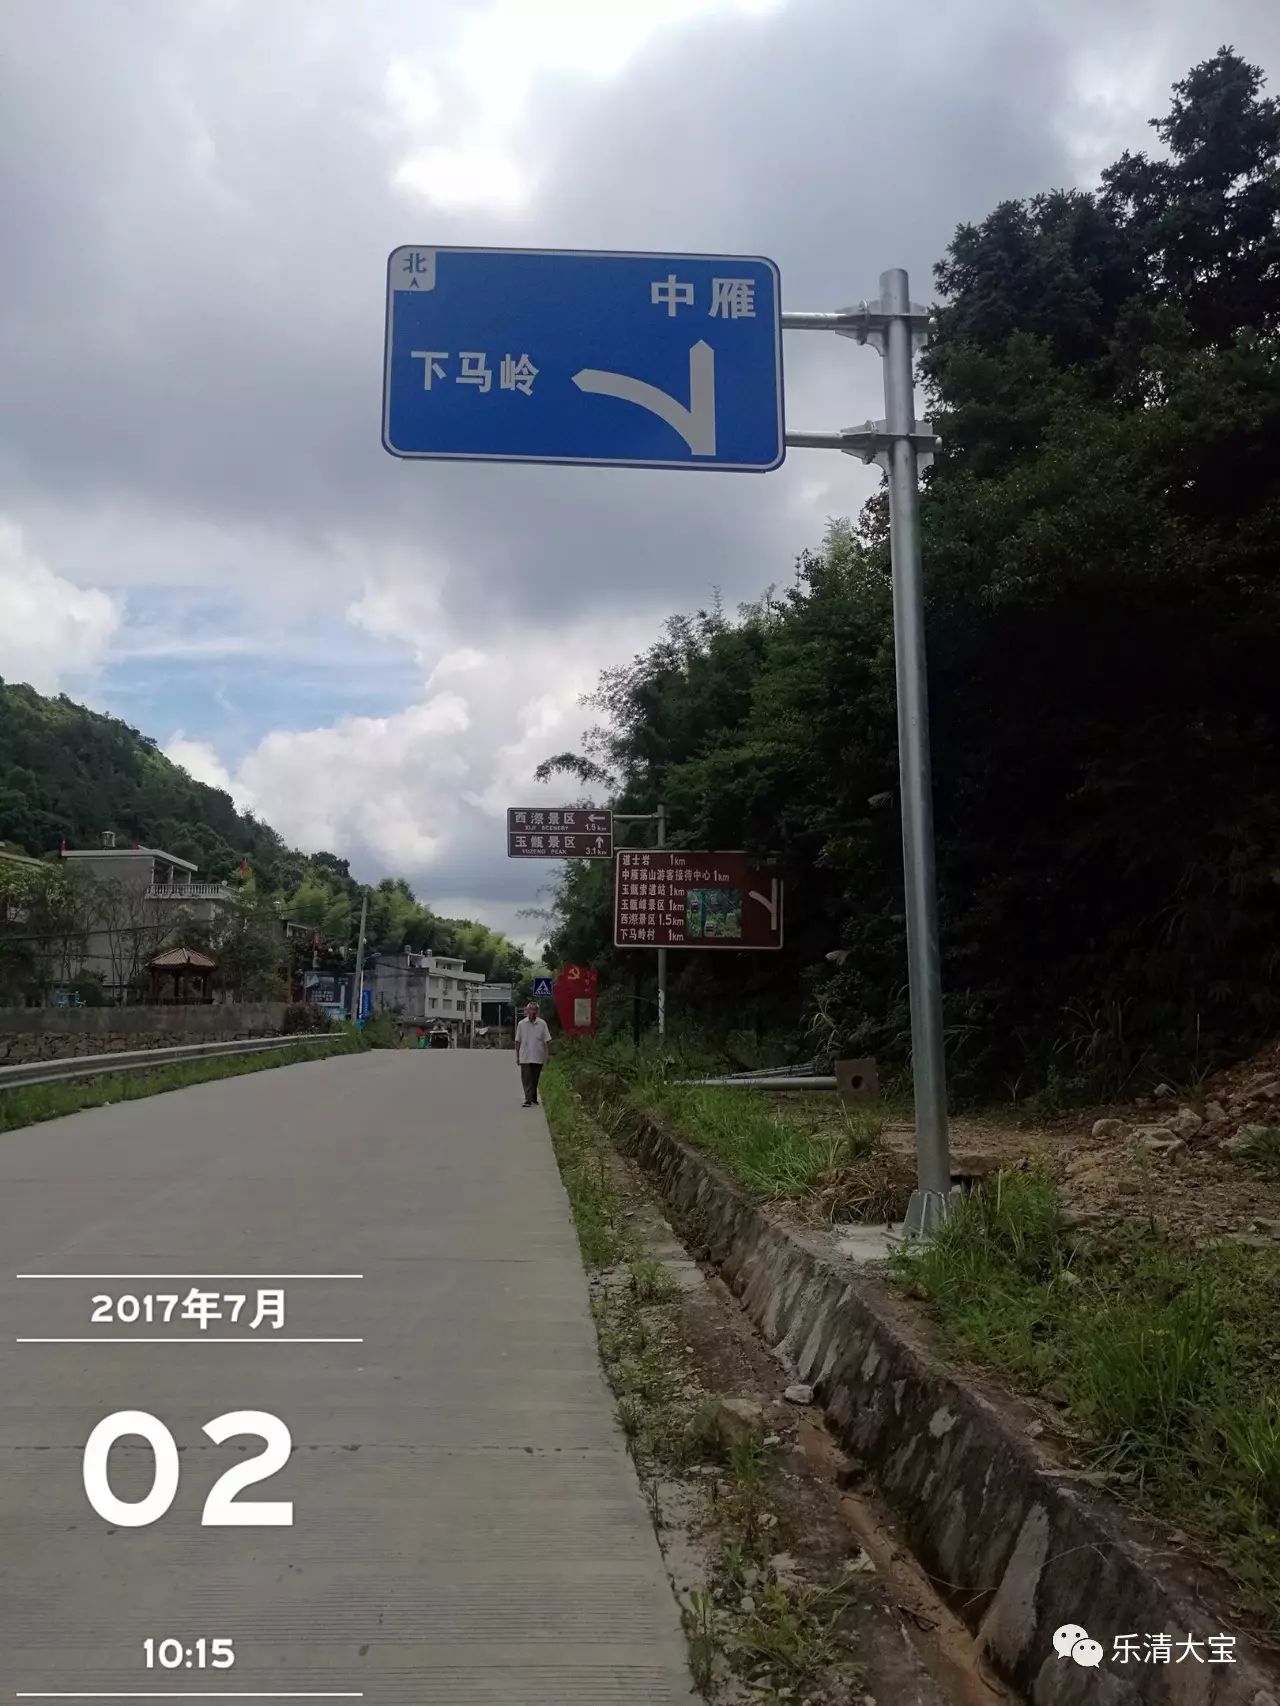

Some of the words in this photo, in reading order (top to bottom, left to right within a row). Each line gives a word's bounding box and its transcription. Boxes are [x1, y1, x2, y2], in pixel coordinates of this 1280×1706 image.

[402, 252, 427, 274] 北
[651, 274, 756, 319] 中雁
[411, 350, 539, 396] 下马岭
[669, 854, 686, 866] 1km
[713, 870, 730, 882] 1km
[669, 884, 685, 896] 1km
[668, 899, 685, 911] 1km
[658, 914, 684, 926] 1.5km
[620, 928, 656, 940] 下马岭村
[668, 929, 684, 941] 1km
